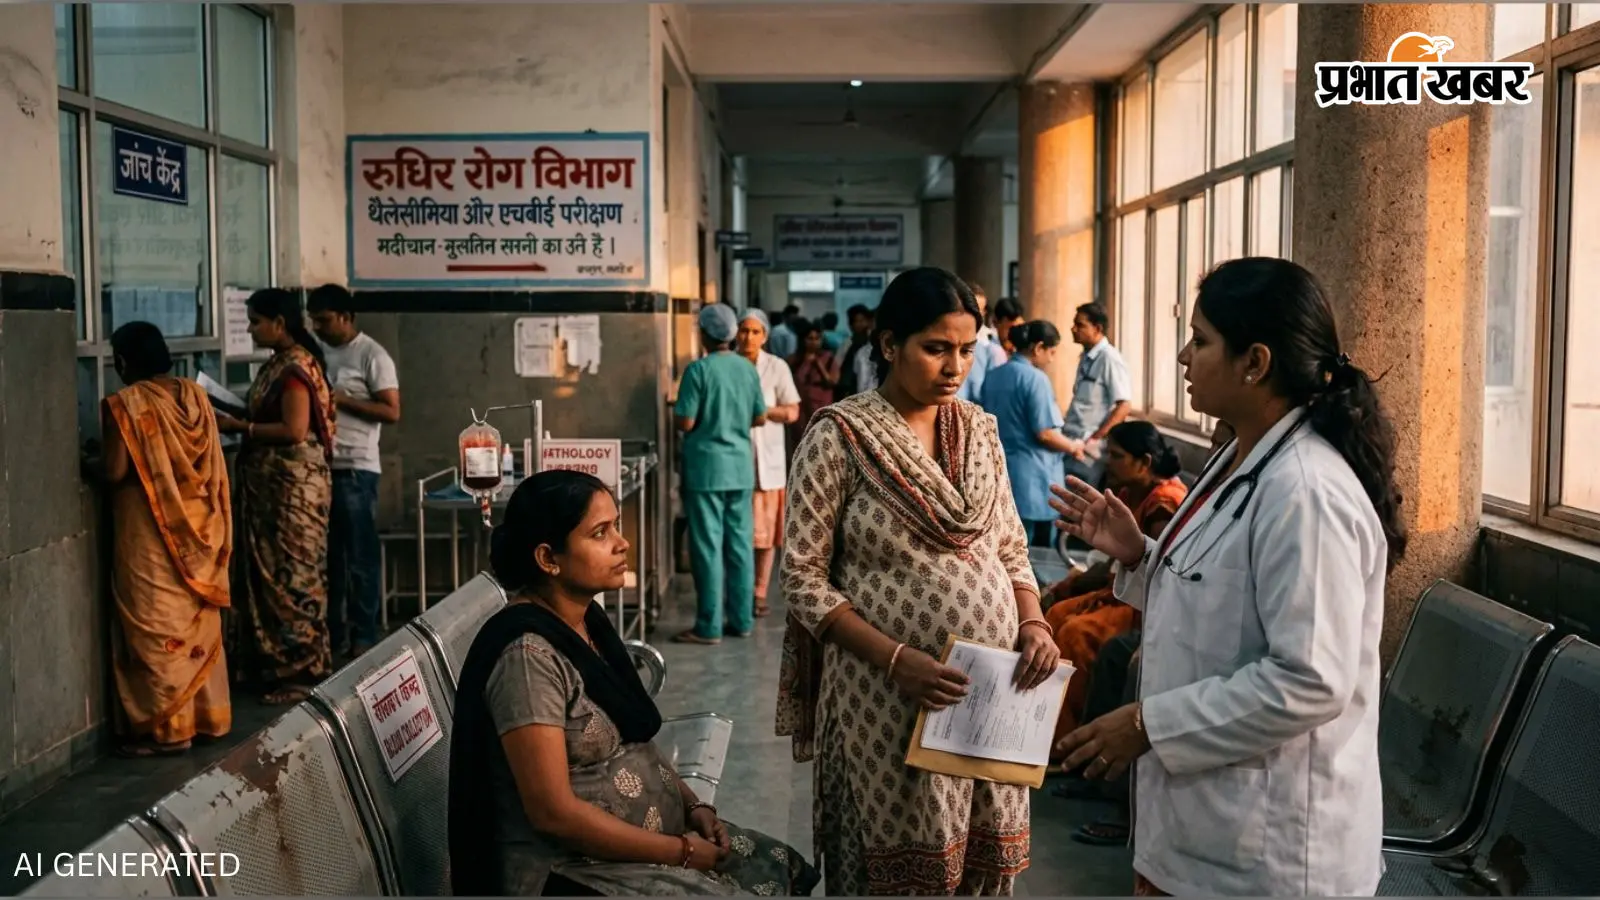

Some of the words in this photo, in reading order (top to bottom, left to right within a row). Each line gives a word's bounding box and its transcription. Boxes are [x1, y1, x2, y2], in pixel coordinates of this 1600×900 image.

[119, 141, 153, 183] जांच
[156, 145, 181, 194] केंद्र
[362, 146, 455, 191] रुधिर
[463, 146, 526, 190] रोग
[531, 146, 636, 189] विभाग
[368, 196, 458, 227] थैलेसीमिया
[463, 196, 494, 227] और
[498, 195, 555, 228] एचबीई
[559, 195, 623, 227] परीक्षण
[542, 237, 562, 255] का
[591, 232, 605, 259] है
